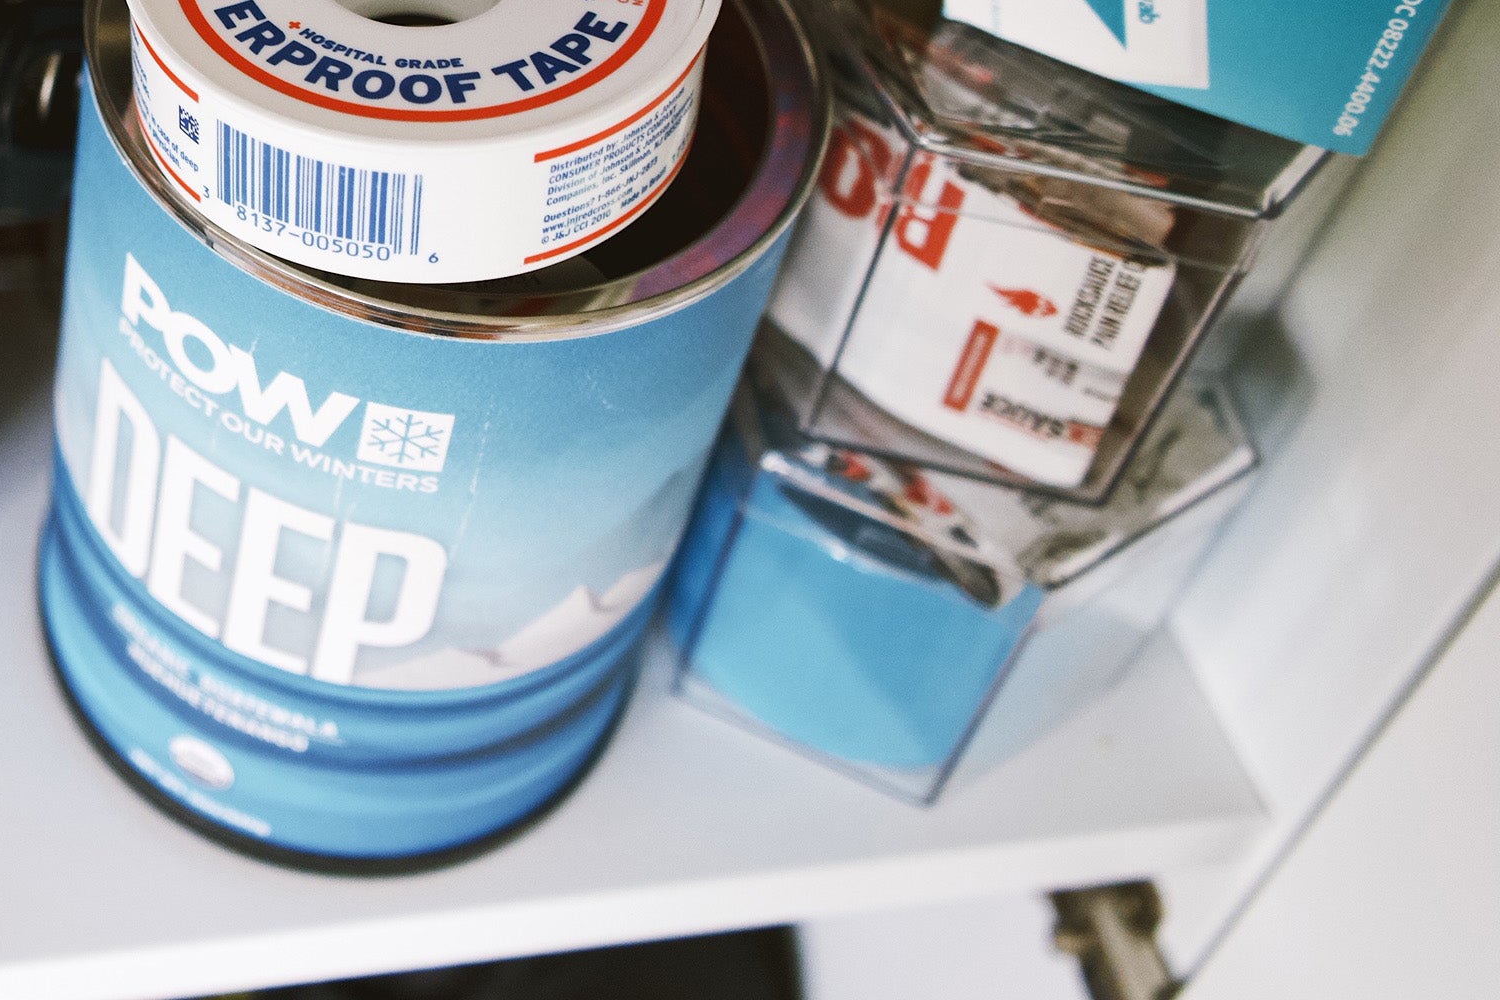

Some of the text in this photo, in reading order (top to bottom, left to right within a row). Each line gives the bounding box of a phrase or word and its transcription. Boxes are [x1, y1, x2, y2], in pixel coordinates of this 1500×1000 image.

[299, 27, 464, 70] HOSPITAL GRADE
[492, 10, 628, 92] TAPE
[180, 150, 199, 173] deep
[547, 175, 586, 196] Division
[600, 152, 634, 175] Johnson
[549, 158, 602, 185] CONSUMER
[603, 134, 646, 163] PRODUCTS
[550, 145, 604, 173] Distributed
[202, 185, 211, 199] 3
[543, 197, 595, 223] Questions?
[236, 205, 391, 262] 8137-005050
[552, 228, 572, 242] J&J
[428, 252, 440, 264] 6
[121, 251, 362, 448] POW
[118, 316, 440, 494] PROTECT OUR WINTERS
[86, 356, 447, 685] DEEP
